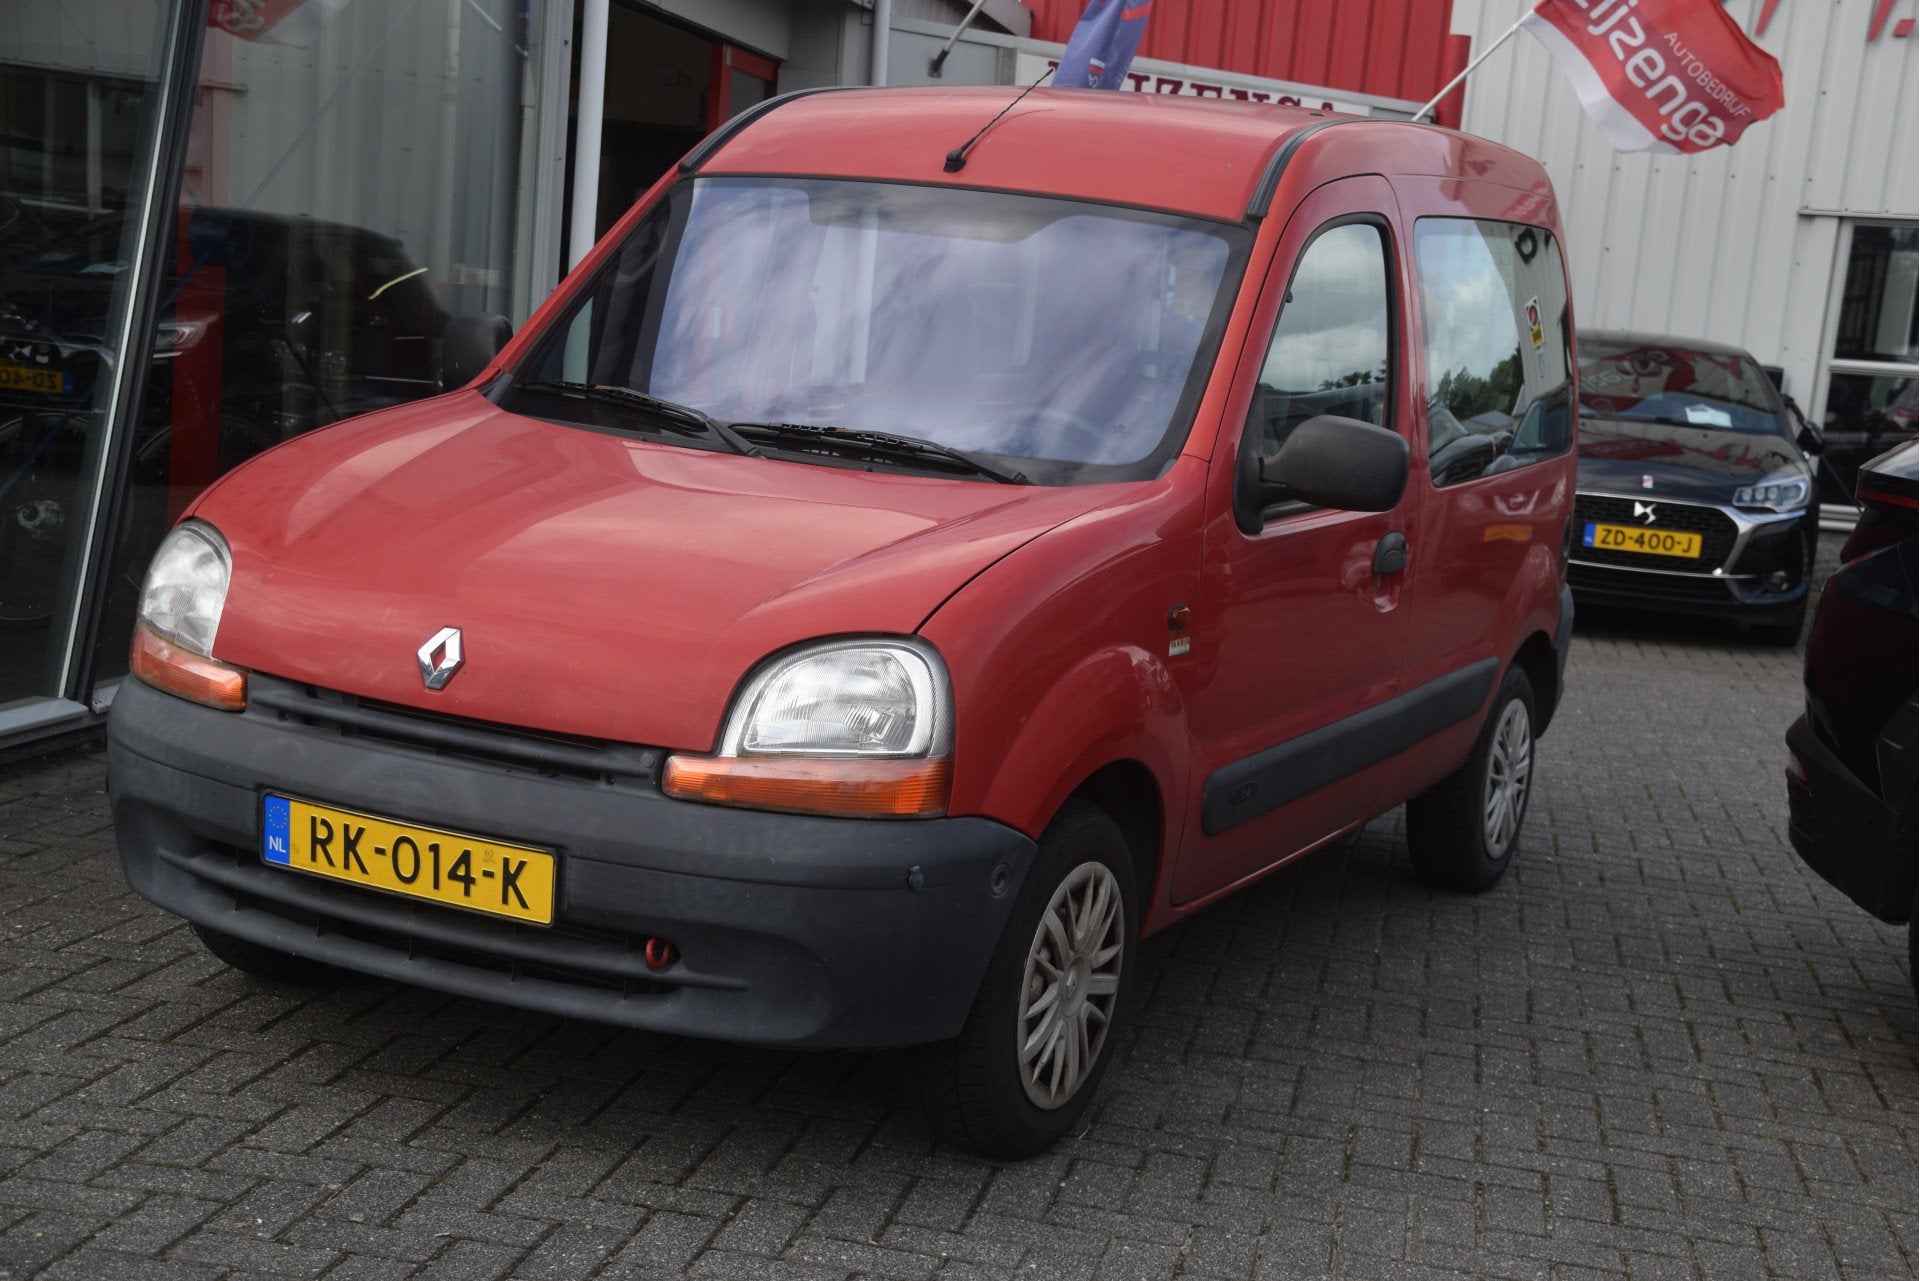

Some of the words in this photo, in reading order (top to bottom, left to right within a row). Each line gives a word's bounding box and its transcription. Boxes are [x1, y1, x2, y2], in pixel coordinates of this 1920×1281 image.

[1574, 0, 1726, 148] ijzenga
[1663, 32, 1751, 117] AUTOBEDRIJF
[1600, 528, 1693, 554] ZD-400-J
[269, 835, 287, 854] NL
[309, 815, 530, 910] RK-014-K
